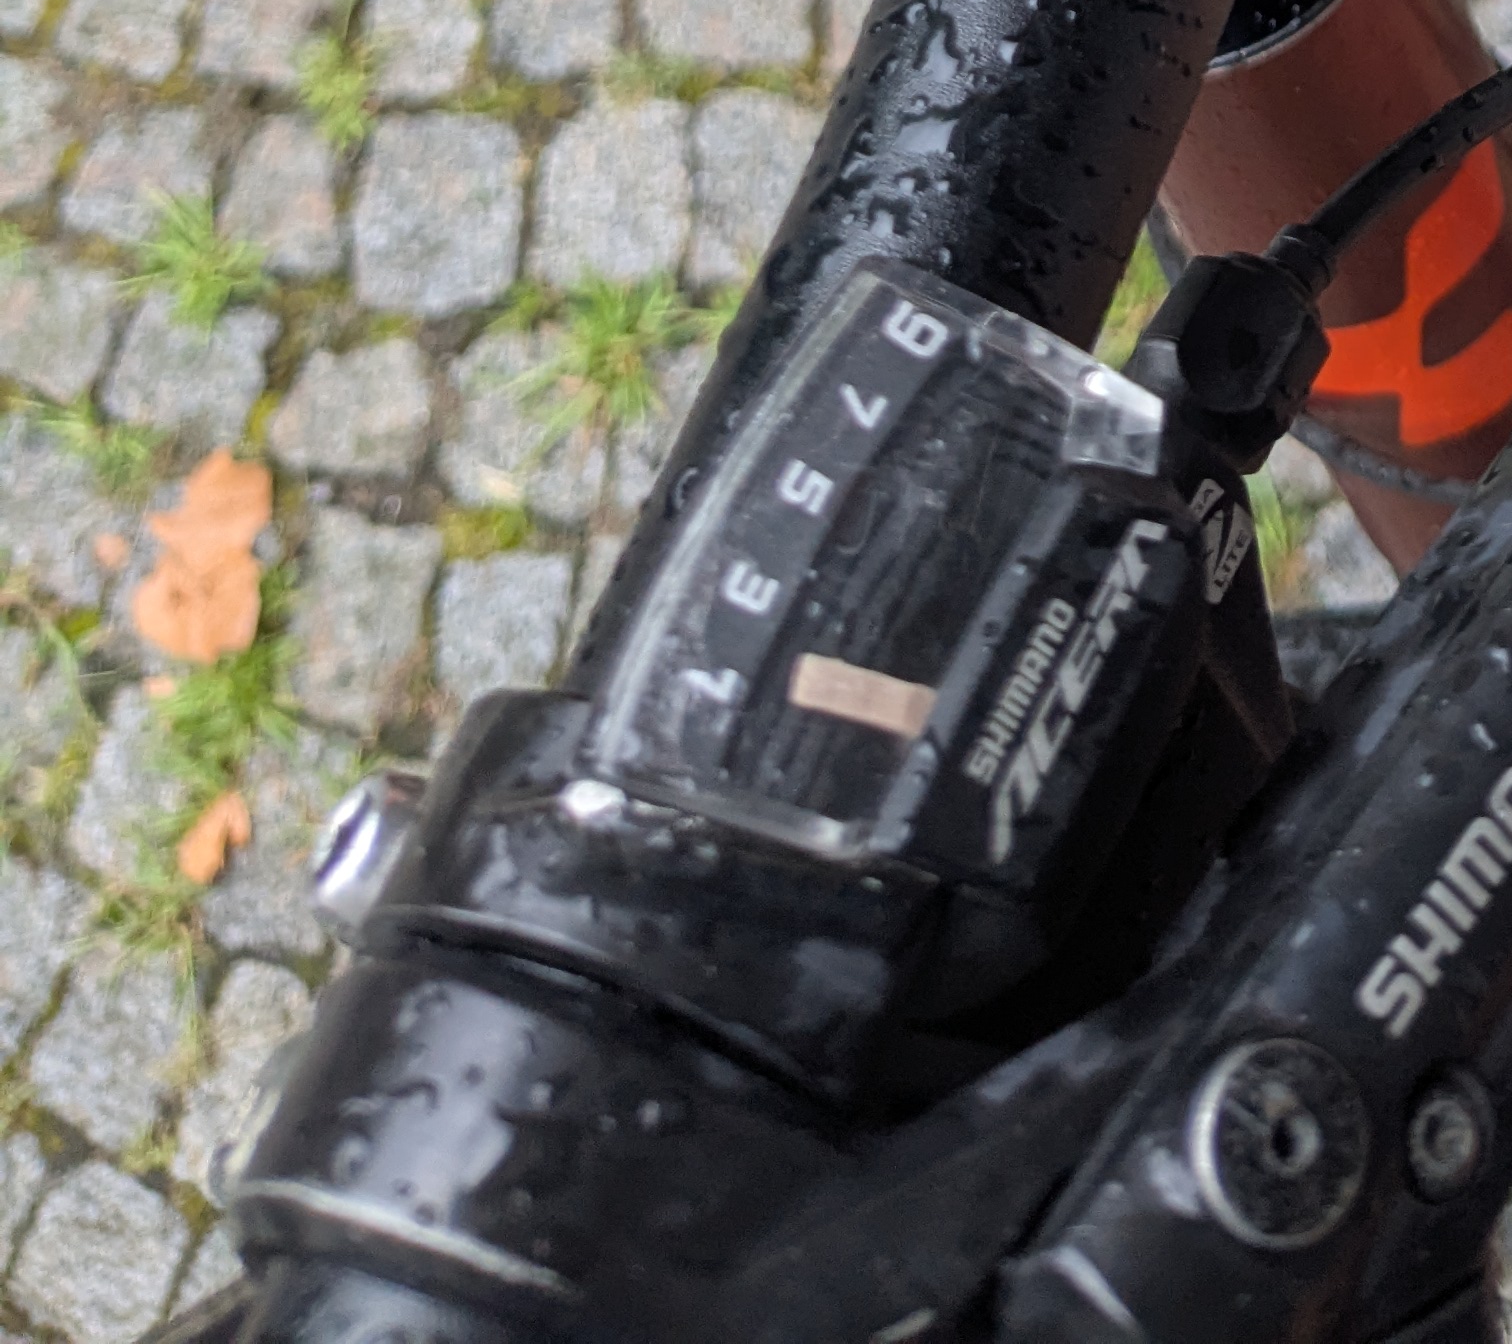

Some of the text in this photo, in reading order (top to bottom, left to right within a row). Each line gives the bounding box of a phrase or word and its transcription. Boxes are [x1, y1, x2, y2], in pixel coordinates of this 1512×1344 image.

[839, 383, 889, 430] 7
[776, 459, 836, 516] 5
[720, 559, 781, 615] 3
[963, 596, 1077, 785] SHIMANO
[985, 518, 1168, 864] ACERA
